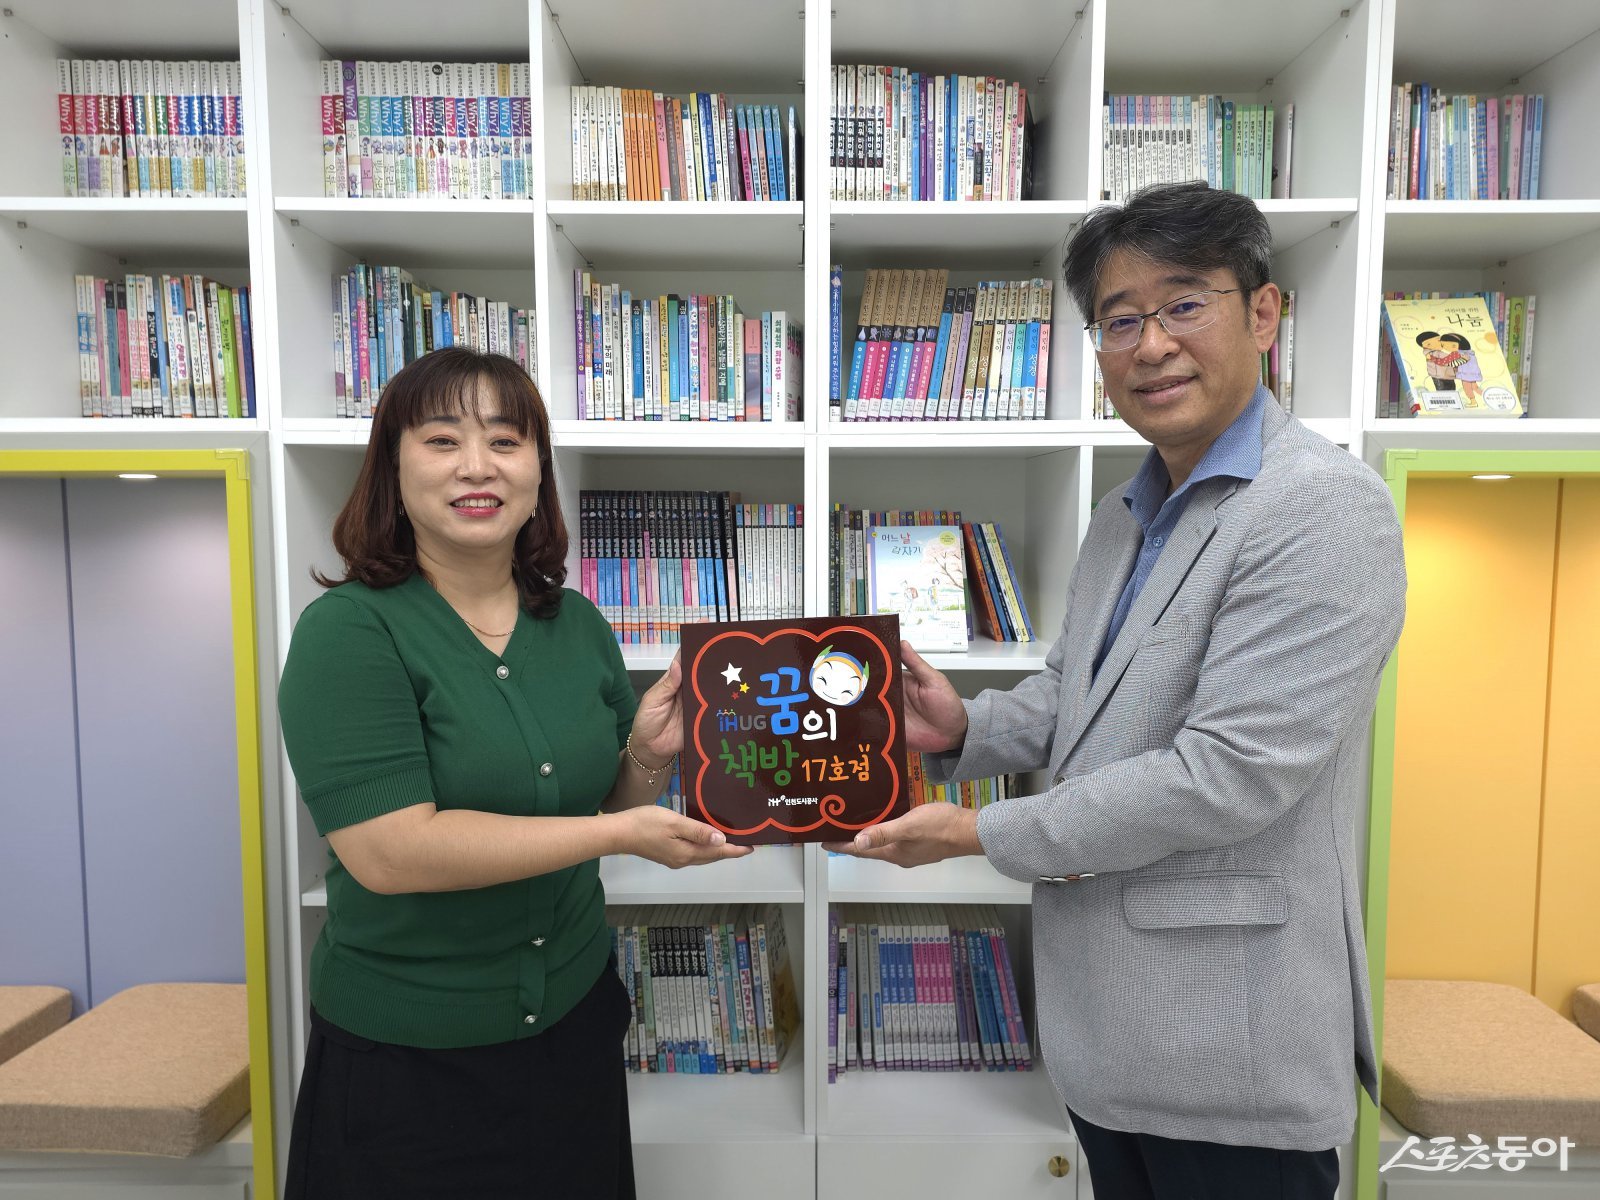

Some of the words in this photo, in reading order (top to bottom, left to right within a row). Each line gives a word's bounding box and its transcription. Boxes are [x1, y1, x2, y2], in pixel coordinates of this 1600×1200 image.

[60, 98, 72, 131] Why?
[74, 98, 85, 133] Why?
[87, 98, 97, 133] Why?
[99, 99, 109, 131] Why?
[169, 99, 179, 132] Why?
[180, 99, 190, 133] Why?
[214, 99, 224, 134] Why?
[226, 99, 236, 134] Why?
[323, 99, 334, 133] Why?
[334, 98, 344, 134] Why?
[346, 84, 356, 120] Why?
[359, 99, 369, 134] Why?
[370, 99, 380, 134] Why?
[382, 99, 391, 134] Why?
[393, 99, 403, 134] Why?
[425, 98, 434, 134] Why?
[435, 99, 444, 134] Why?
[447, 99, 456, 135] Why?
[457, 99, 466, 136] Why?
[468, 99, 477, 136] Why?
[489, 99, 498, 134] Why?
[500, 99, 510, 135] Why?
[513, 99, 522, 135] Why?
[986, 131, 993, 150] 도전
[984, 151, 992, 177] 퀴즈왕
[1447, 314, 1483, 328] 나눔
[604, 345, 611, 359] 부의
[972, 330, 980, 351] 어린이
[983, 331, 991, 351] 어린이
[995, 330, 1003, 352] 어린이
[605, 362, 612, 376] 미래
[718, 372, 726, 386] 지혜
[969, 356, 978, 379] 성경
[979, 356, 988, 377] 성경
[1029, 354, 1037, 376] 성경
[901, 533, 911, 544] 날
[719, 715, 766, 732] iHUG
[756, 666, 837, 741] 꿈의
[719, 739, 799, 787] 책방
[802, 755, 871, 782] 17호점
[785, 797, 818, 805] 인천도시공사
